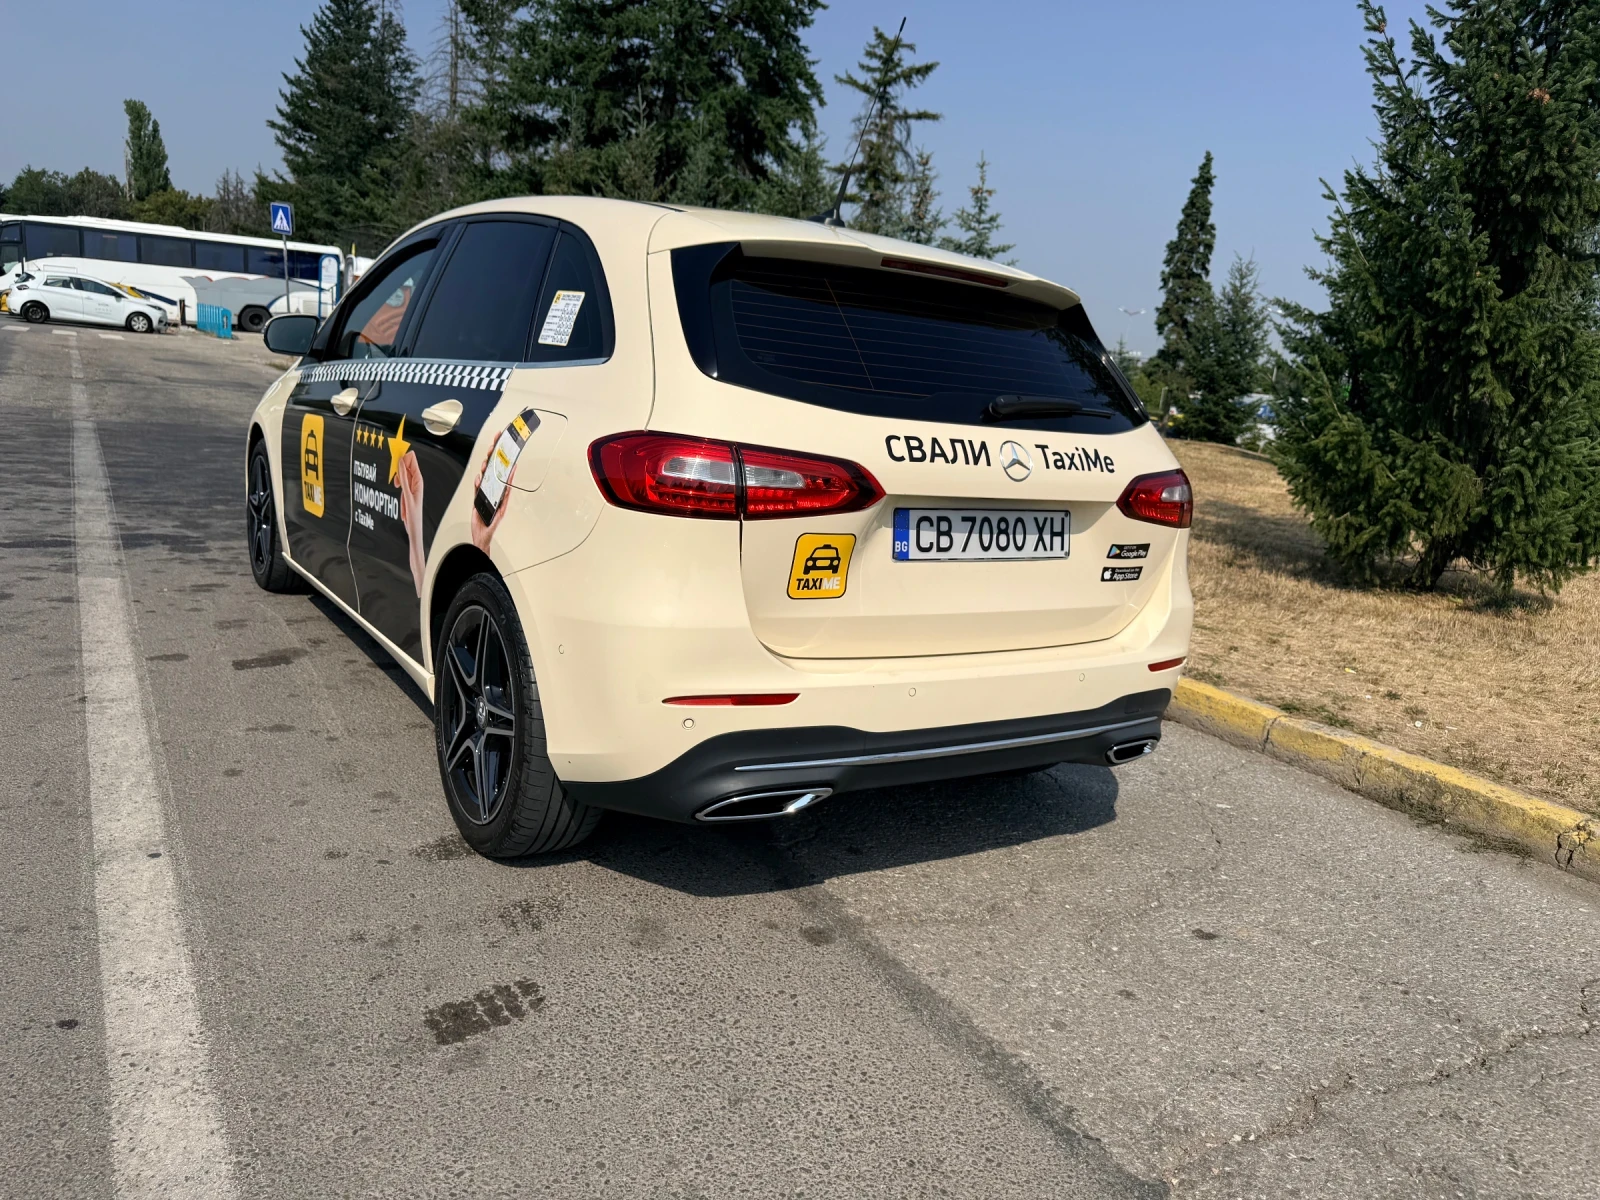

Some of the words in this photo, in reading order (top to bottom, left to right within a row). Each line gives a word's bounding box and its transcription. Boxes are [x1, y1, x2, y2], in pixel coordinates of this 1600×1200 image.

[885, 434, 992, 467] СВАЛИ
[1034, 443, 1116, 474] TaxiMe
[353, 482, 399, 521] КОМФОРТНО
[894, 541, 908, 552] BG
[960, 516, 1027, 553] 7080
[1120, 550, 1137, 558] Google
[1138, 550, 1147, 558] Play
[1113, 573, 1125, 581] App
